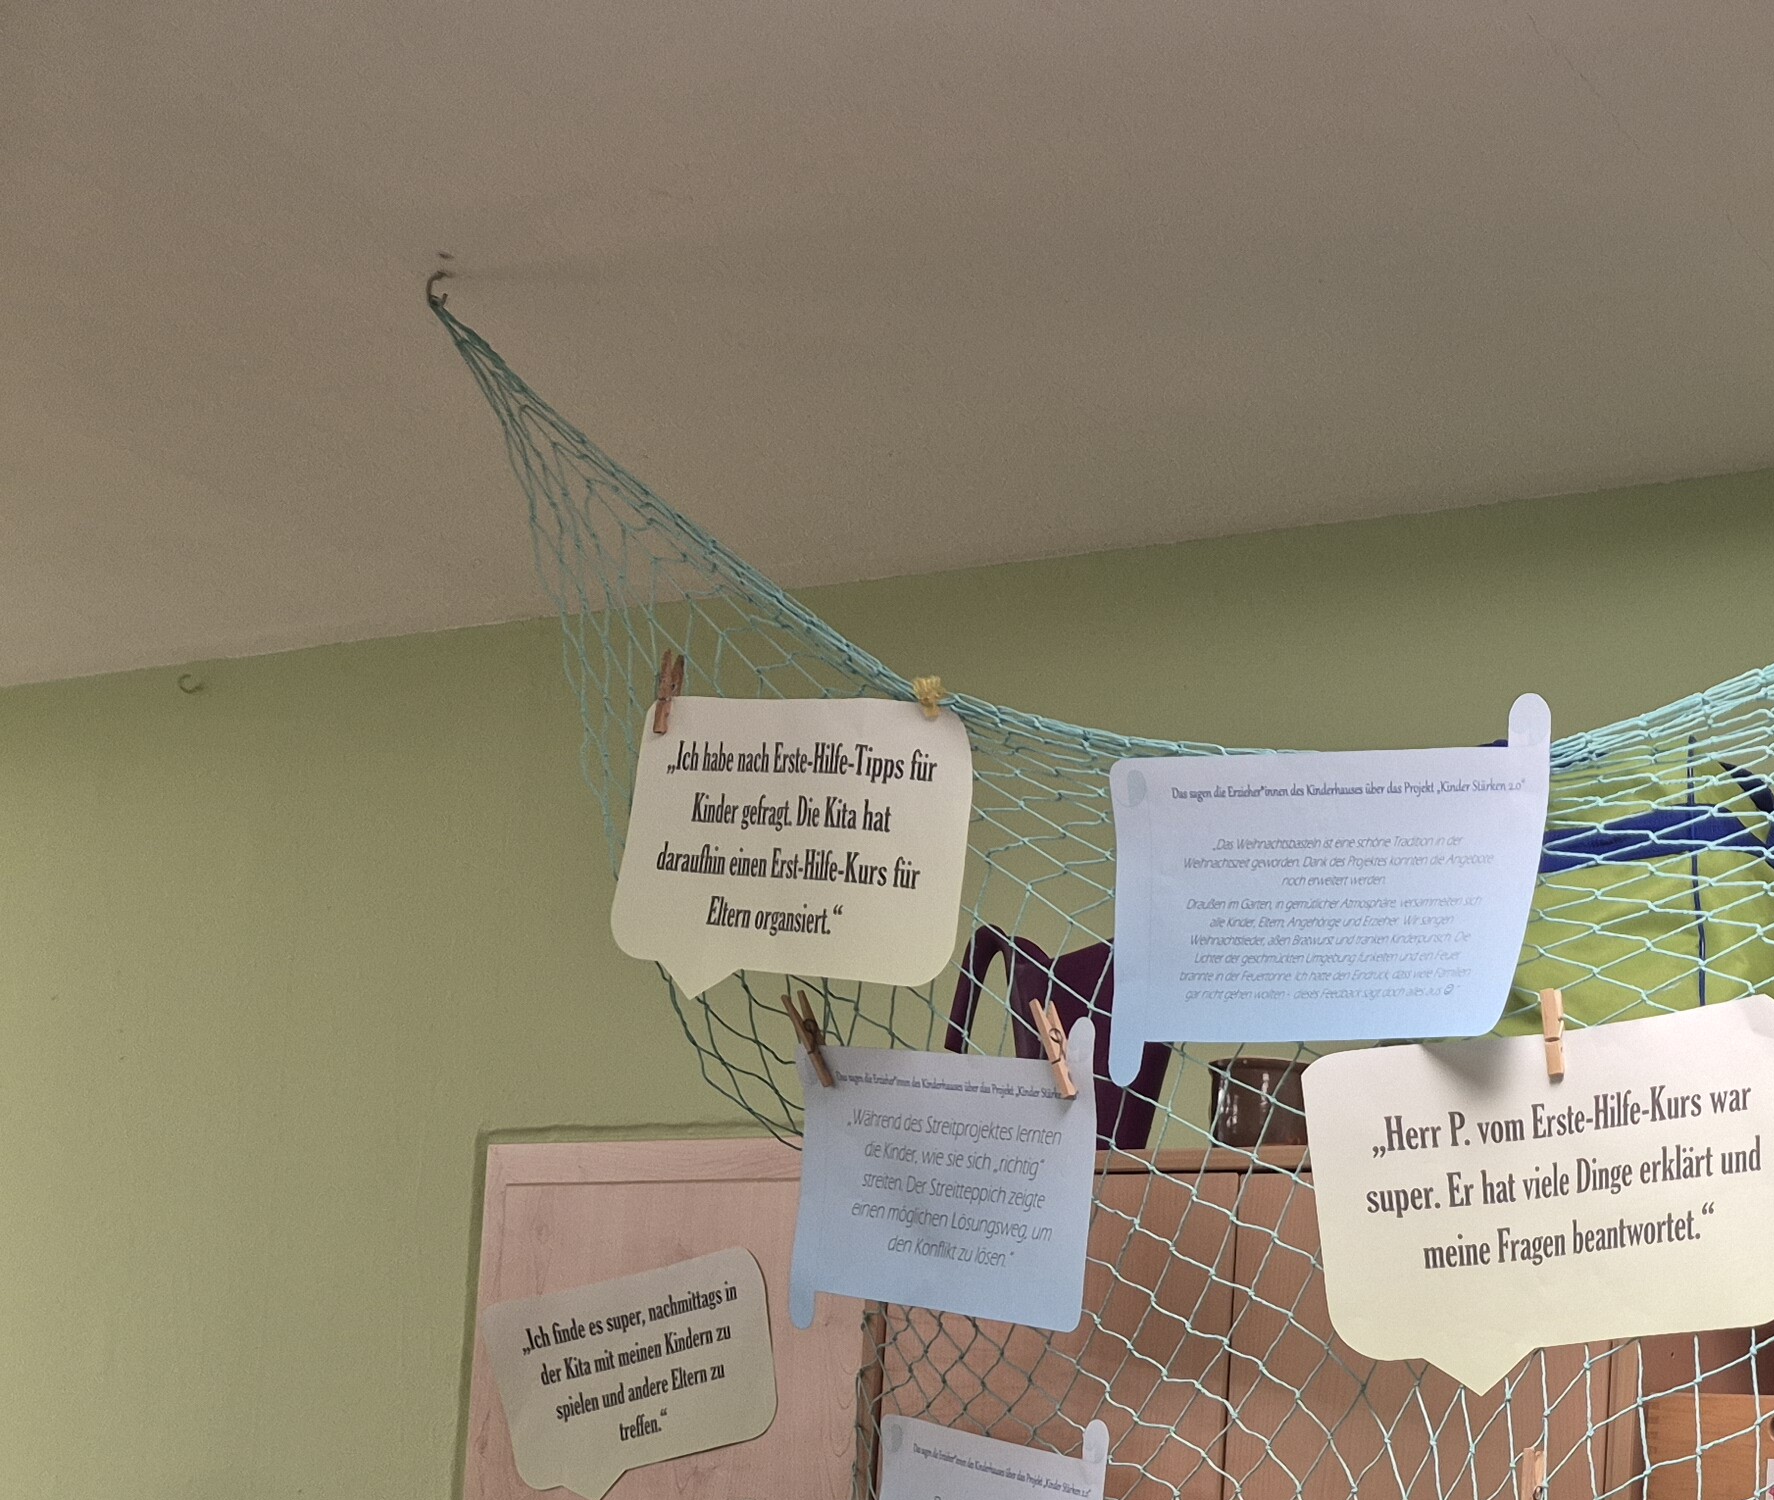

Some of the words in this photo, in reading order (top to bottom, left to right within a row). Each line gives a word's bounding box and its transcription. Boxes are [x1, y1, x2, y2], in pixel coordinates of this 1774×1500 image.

[667, 741, 699, 773] „Ich
[702, 742, 733, 772] habe
[737, 742, 769, 773] nach
[773, 742, 904, 784] Erste-Hilfe-Tipps
[910, 749, 937, 781] für
[692, 792, 738, 824] Kinder
[741, 795, 792, 831] gefragt.
[797, 796, 820, 827] Die
[824, 796, 856, 829] Kita
[863, 799, 891, 832] hat
[657, 841, 725, 875] daraufhin
[729, 848, 767, 877] einen
[771, 848, 887, 886] Erst-Hilfe-Kurs
[893, 857, 920, 889] für
[706, 896, 751, 928] Eltern
[755, 904, 842, 936] organsiert.“
[904, 1117, 923, 1132] des
[925, 1116, 1013, 1143] Streitprojektes
[1016, 1125, 1062, 1145] lernten
[1373, 1116, 1441, 1158] „Herr
[1449, 1112, 1470, 1146] P.
[1477, 1119, 1524, 1143] vom
[1532, 1085, 1701, 1139] Erste-Hilfe-Kurs
[1710, 1088, 1751, 1113] war
[1367, 1187, 1440, 1218] super.
[1447, 1172, 1473, 1207] Er
[1481, 1170, 1516, 1204] hat
[1523, 1162, 1569, 1199] viele
[1577, 1158, 1632, 1194] Dinge
[1640, 1145, 1713, 1184] erklärt
[1721, 1135, 1761, 1174] und
[1424, 1234, 1490, 1269] meine
[1497, 1228, 1565, 1265] Fragen
[1573, 1202, 1714, 1254] beantwortet.“
[523, 1326, 551, 1354] „Ich
[552, 1318, 585, 1344] finde
[589, 1321, 603, 1336] es
[606, 1311, 645, 1333] super,
[648, 1290, 722, 1321] nachmittags
[725, 1281, 737, 1301] in
[541, 1363, 561, 1385] der
[564, 1357, 591, 1379] Kita
[594, 1350, 615, 1372] mit
[618, 1342, 662, 1367] meinen
[664, 1327, 713, 1355] Kindern
[716, 1326, 731, 1341] zu
[556, 1392, 599, 1422] spielen
[602, 1382, 625, 1408] und
[628, 1376, 668, 1402] andere
[671, 1367, 707, 1390] Eltern
[710, 1365, 725, 1380] zu
[619, 1409, 667, 1441] treffen.“
